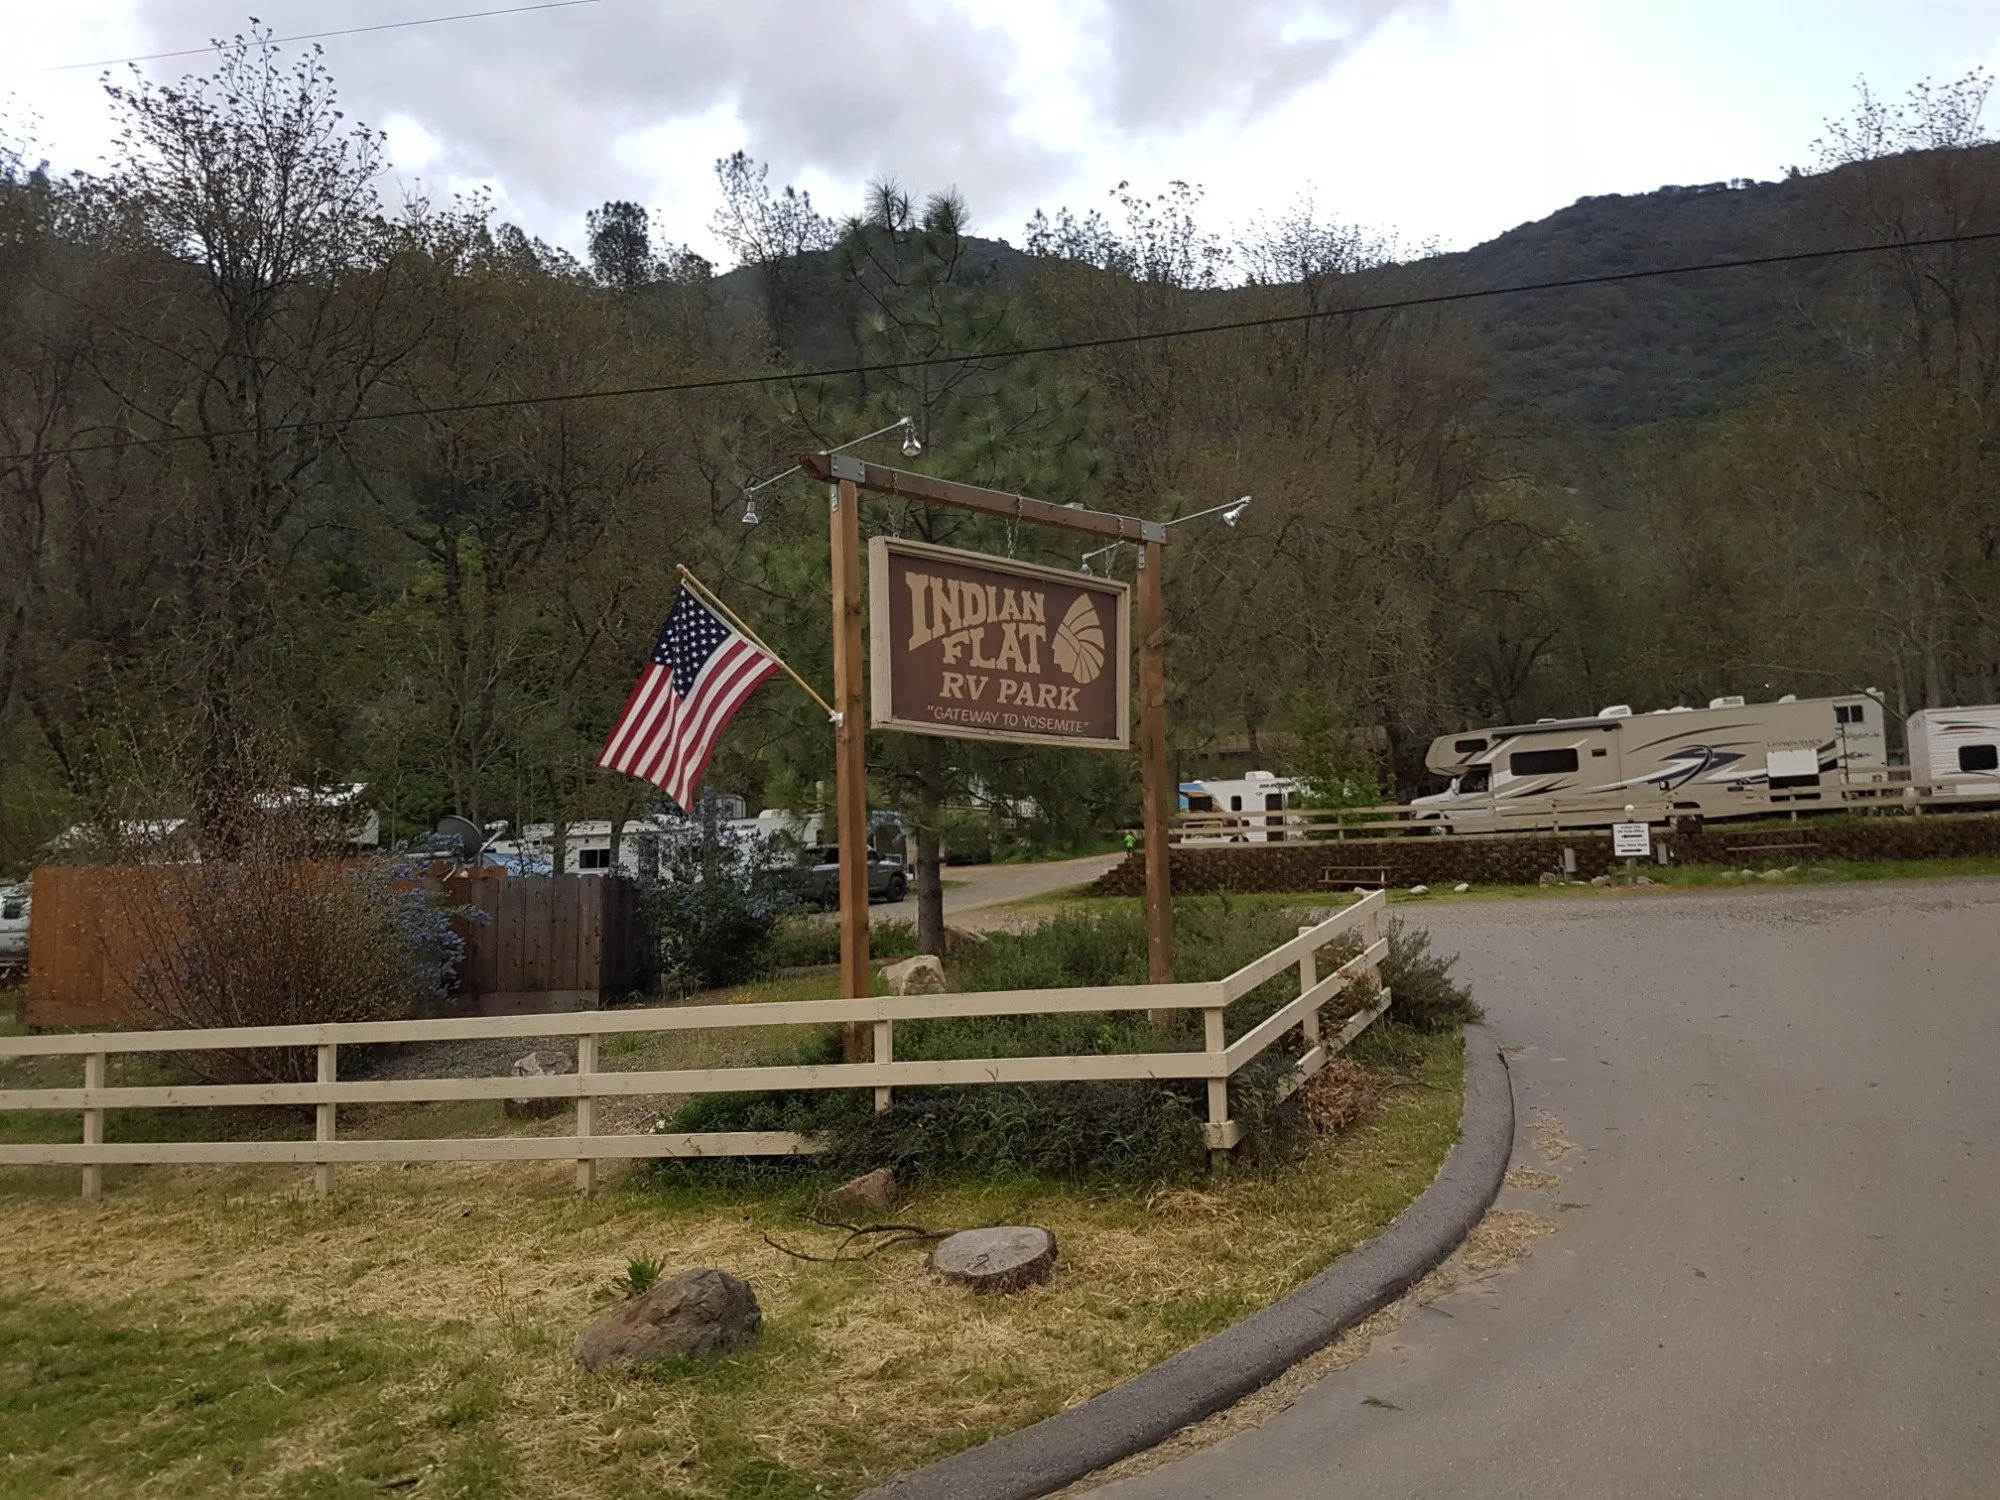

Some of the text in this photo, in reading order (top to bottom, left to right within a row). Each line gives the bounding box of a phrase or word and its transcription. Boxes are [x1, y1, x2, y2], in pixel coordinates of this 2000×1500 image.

[905, 571, 1046, 651] INDIAN
[942, 622, 1046, 674] FLAT
[939, 671, 1080, 712] RV PARK
[927, 705, 1090, 733] "GATEWAY TO YOSEMITE"
